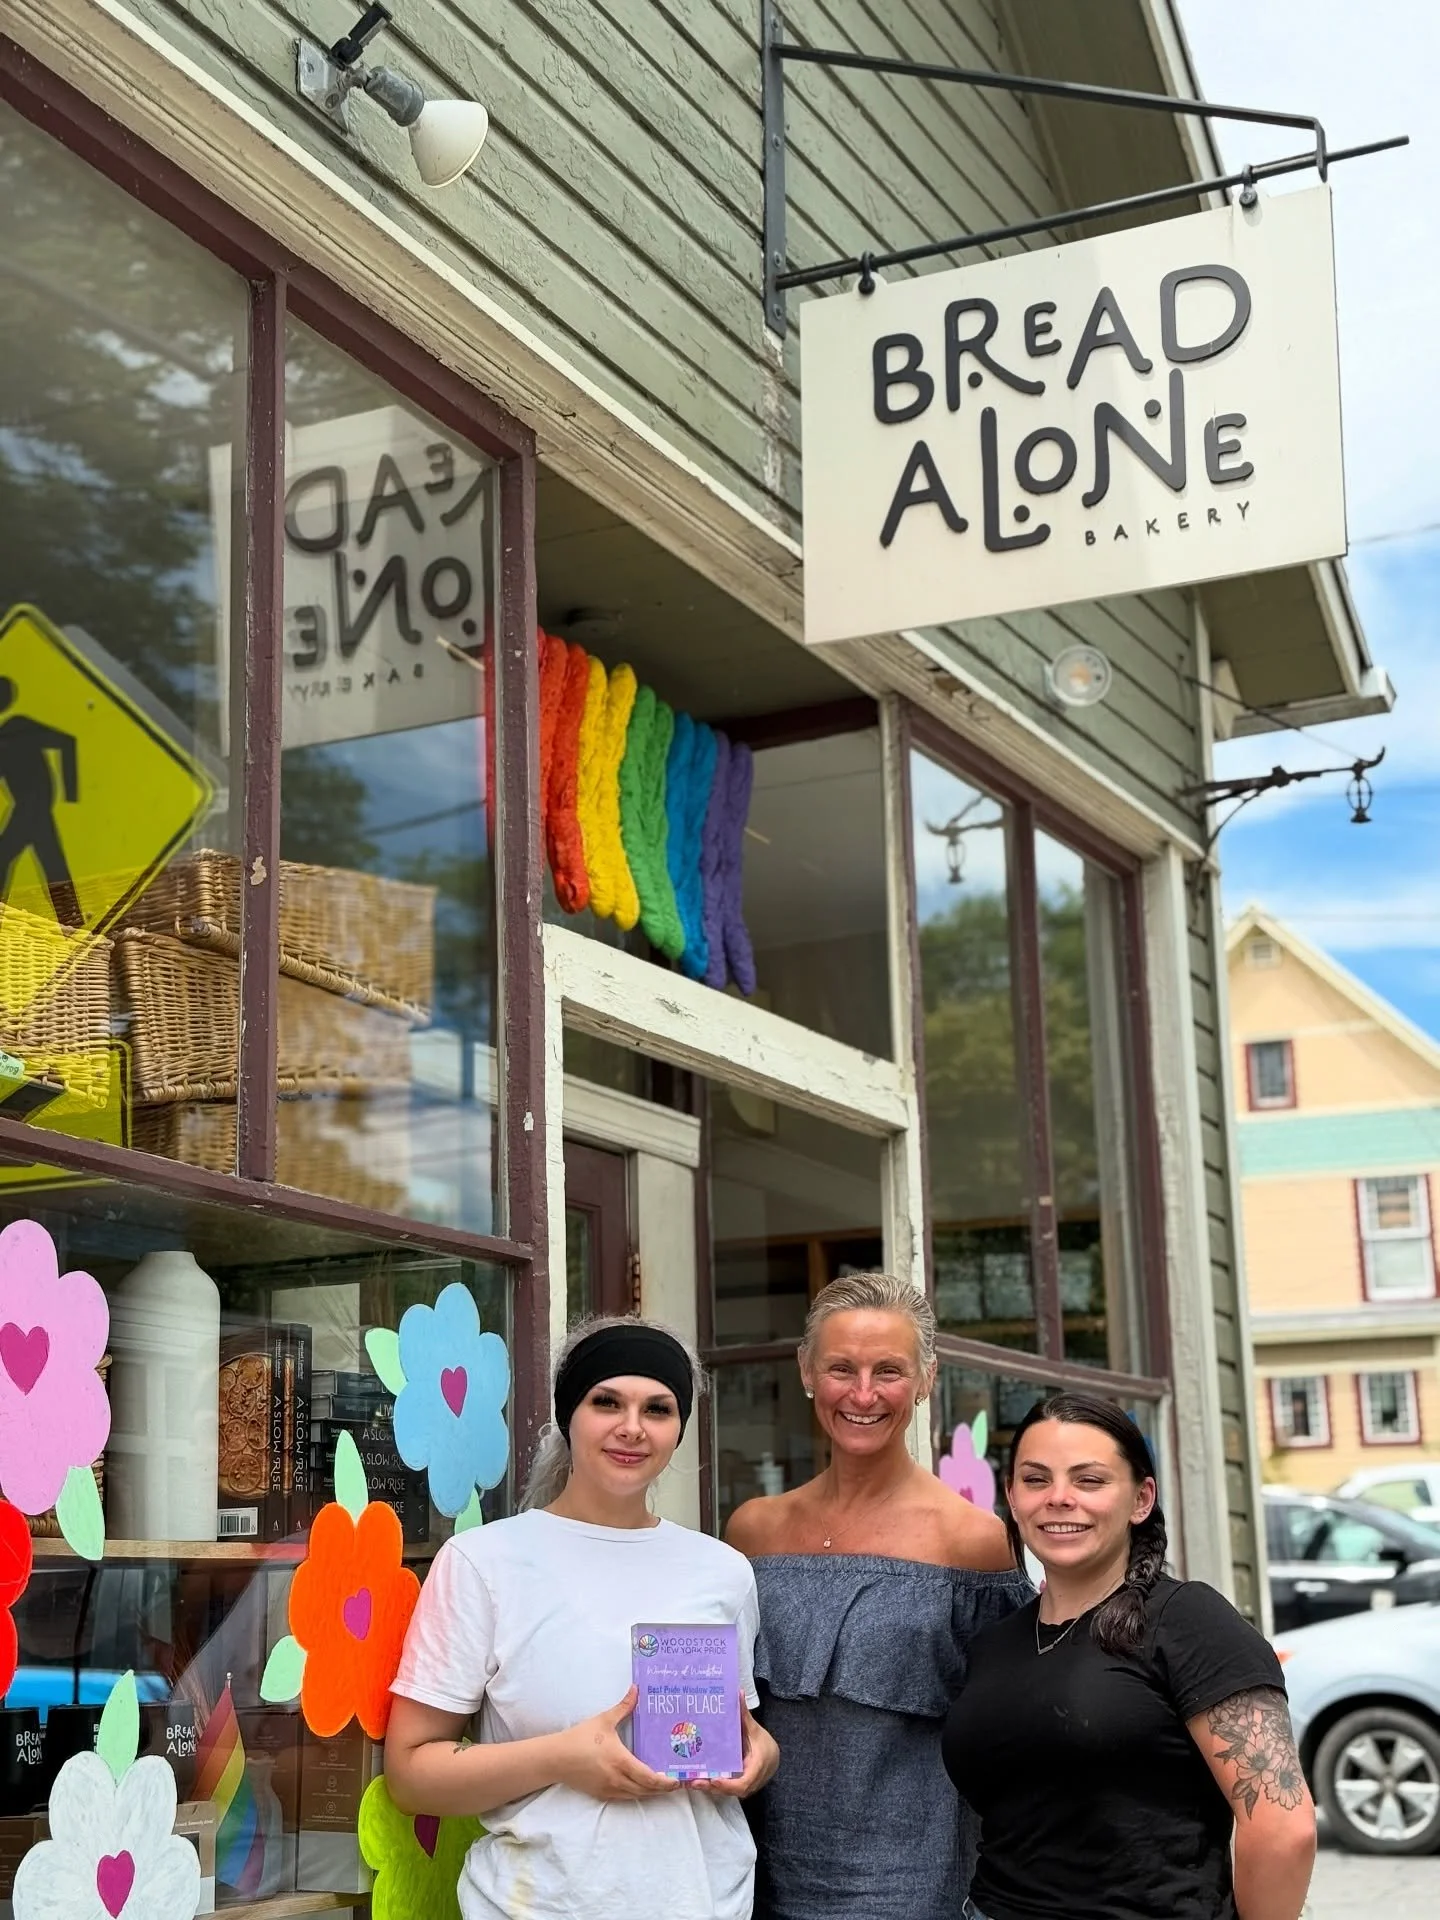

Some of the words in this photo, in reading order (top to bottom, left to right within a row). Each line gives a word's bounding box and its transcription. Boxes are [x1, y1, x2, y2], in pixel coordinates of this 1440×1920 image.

[873, 264, 1252, 424] BREAD
[880, 368, 1254, 553] ALONE
[1085, 501, 1251, 546] BAKERY
[273, 1395, 282, 1408] A
[296, 1396, 305, 1409] A
[273, 1411, 282, 1454] SLOW
[296, 1412, 304, 1454] SLOW
[366, 1453, 389, 1466] SLOW
[271, 1457, 281, 1491] RISE
[293, 1458, 304, 1491] RISE
[367, 1477, 386, 1490] LOW
[387, 1477, 406, 1495] RISE
[660, 1637, 726, 1647] WOODSTOCK
[661, 1646, 679, 1654] NEW
[680, 1647, 703, 1655] YORK
[704, 1647, 727, 1655] PRIDE
[648, 1694, 682, 1714] FIRST
[686, 1694, 726, 1714] PLACE
[16, 1731, 41, 1747] BREA
[166, 1738, 197, 1757] ALON
[16, 1745, 42, 1765] ALON
